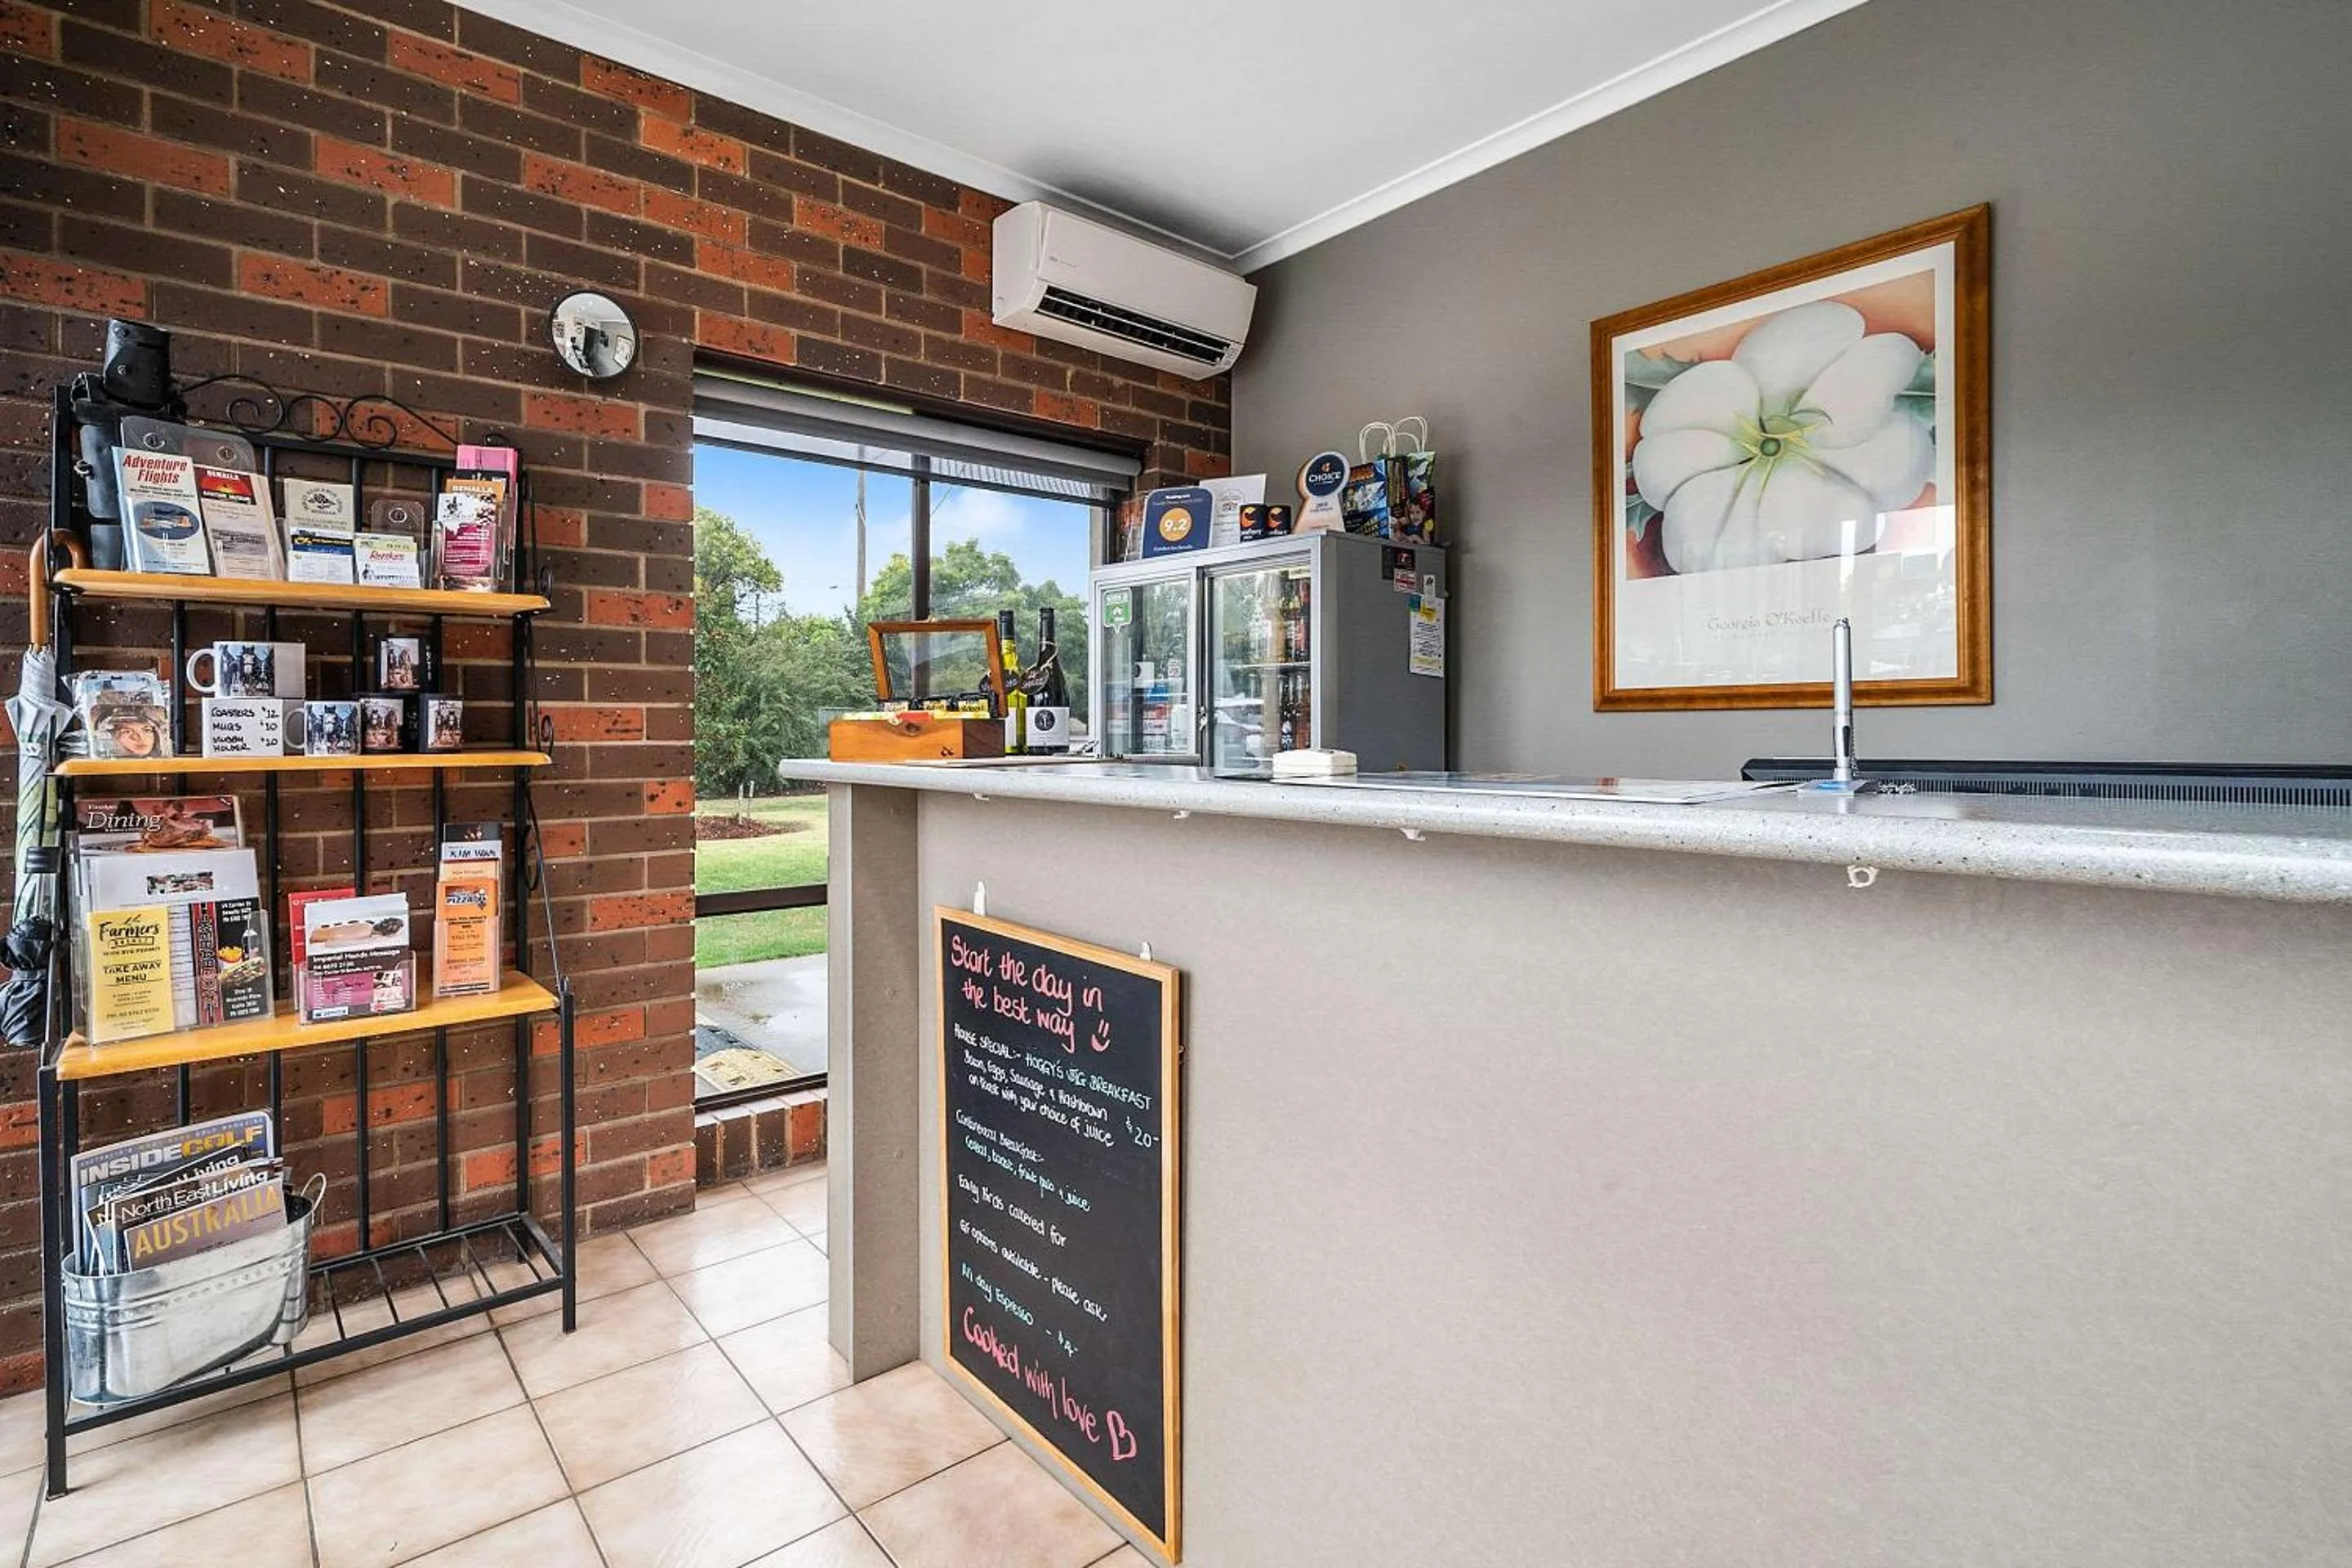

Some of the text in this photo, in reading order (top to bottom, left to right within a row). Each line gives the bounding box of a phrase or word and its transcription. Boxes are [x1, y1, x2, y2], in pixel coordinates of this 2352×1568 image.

[123, 454, 188, 471] Adventure
[137, 470, 180, 485] Flights
[1308, 471, 1341, 482] CHOICE
[1164, 519, 1187, 531] 9.2
[213, 722, 242, 731] MUGS
[86, 811, 164, 831] Dining
[451, 849, 470, 858] KIM
[99, 921, 159, 941] Farmers
[104, 962, 161, 974] TAKE AWAY
[313, 954, 343, 964] Imperial
[116, 973, 147, 983] MENU
[951, 935, 1102, 1016] Start the day in
[962, 978, 1075, 1054] the best way
[1089, 1075, 1152, 1110] BREAKFAST
[1020, 1096, 1037, 1112] your
[1040, 1103, 1068, 1125] choice
[1070, 1116, 1080, 1134] of
[1084, 1119, 1114, 1147] juice
[122, 1196, 171, 1220] North
[134, 1185, 280, 1258] AUSTRALIA
[1050, 1225, 1067, 1247] for
[964, 1306, 1100, 1443] Cooked with love
